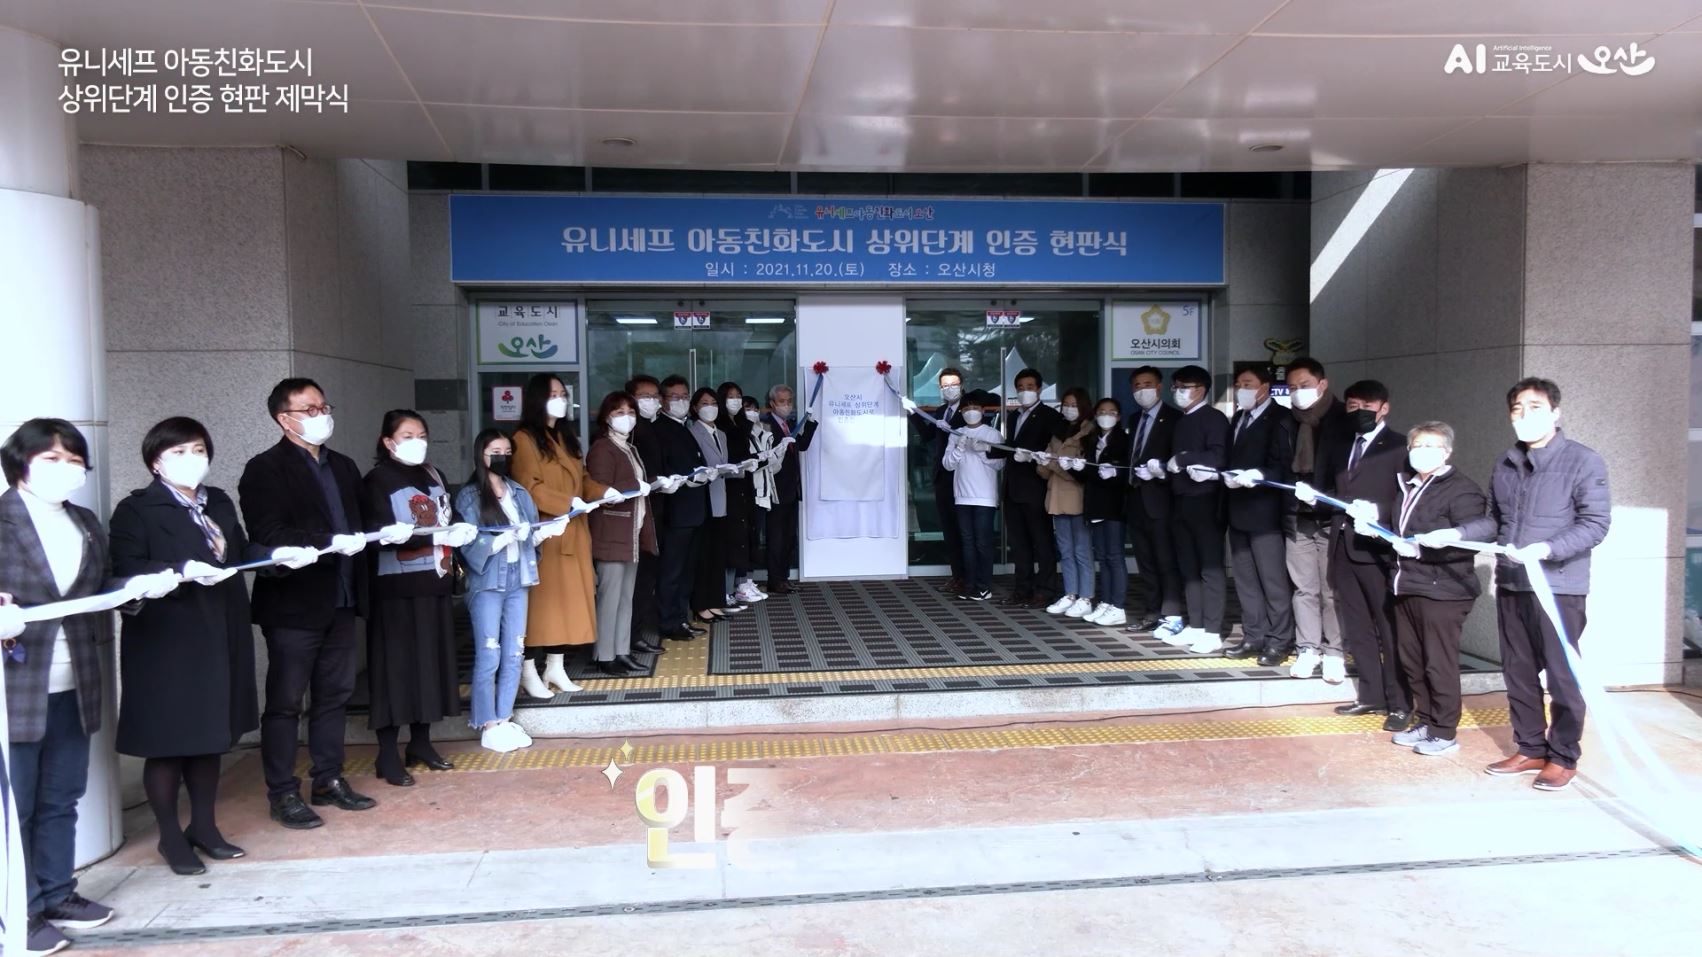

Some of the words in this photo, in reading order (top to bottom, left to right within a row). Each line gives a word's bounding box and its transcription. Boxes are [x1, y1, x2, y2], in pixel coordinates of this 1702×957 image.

[561, 226, 676, 254] 유니세프
[687, 227, 854, 255] 아동친화도시
[866, 229, 974, 256] 상위단계
[986, 229, 1039, 256] 인증
[1050, 230, 1128, 257] 현판식
[705, 262, 735, 278] 일시
[756, 262, 865, 278] 2021.11.20.(토)
[888, 262, 918, 278] 장소
[937, 262, 996, 278] 오산시청
[497, 305, 559, 319] 교육도시
[497, 333, 559, 359] 오산
[1130, 338, 1182, 350] 오산시의회
